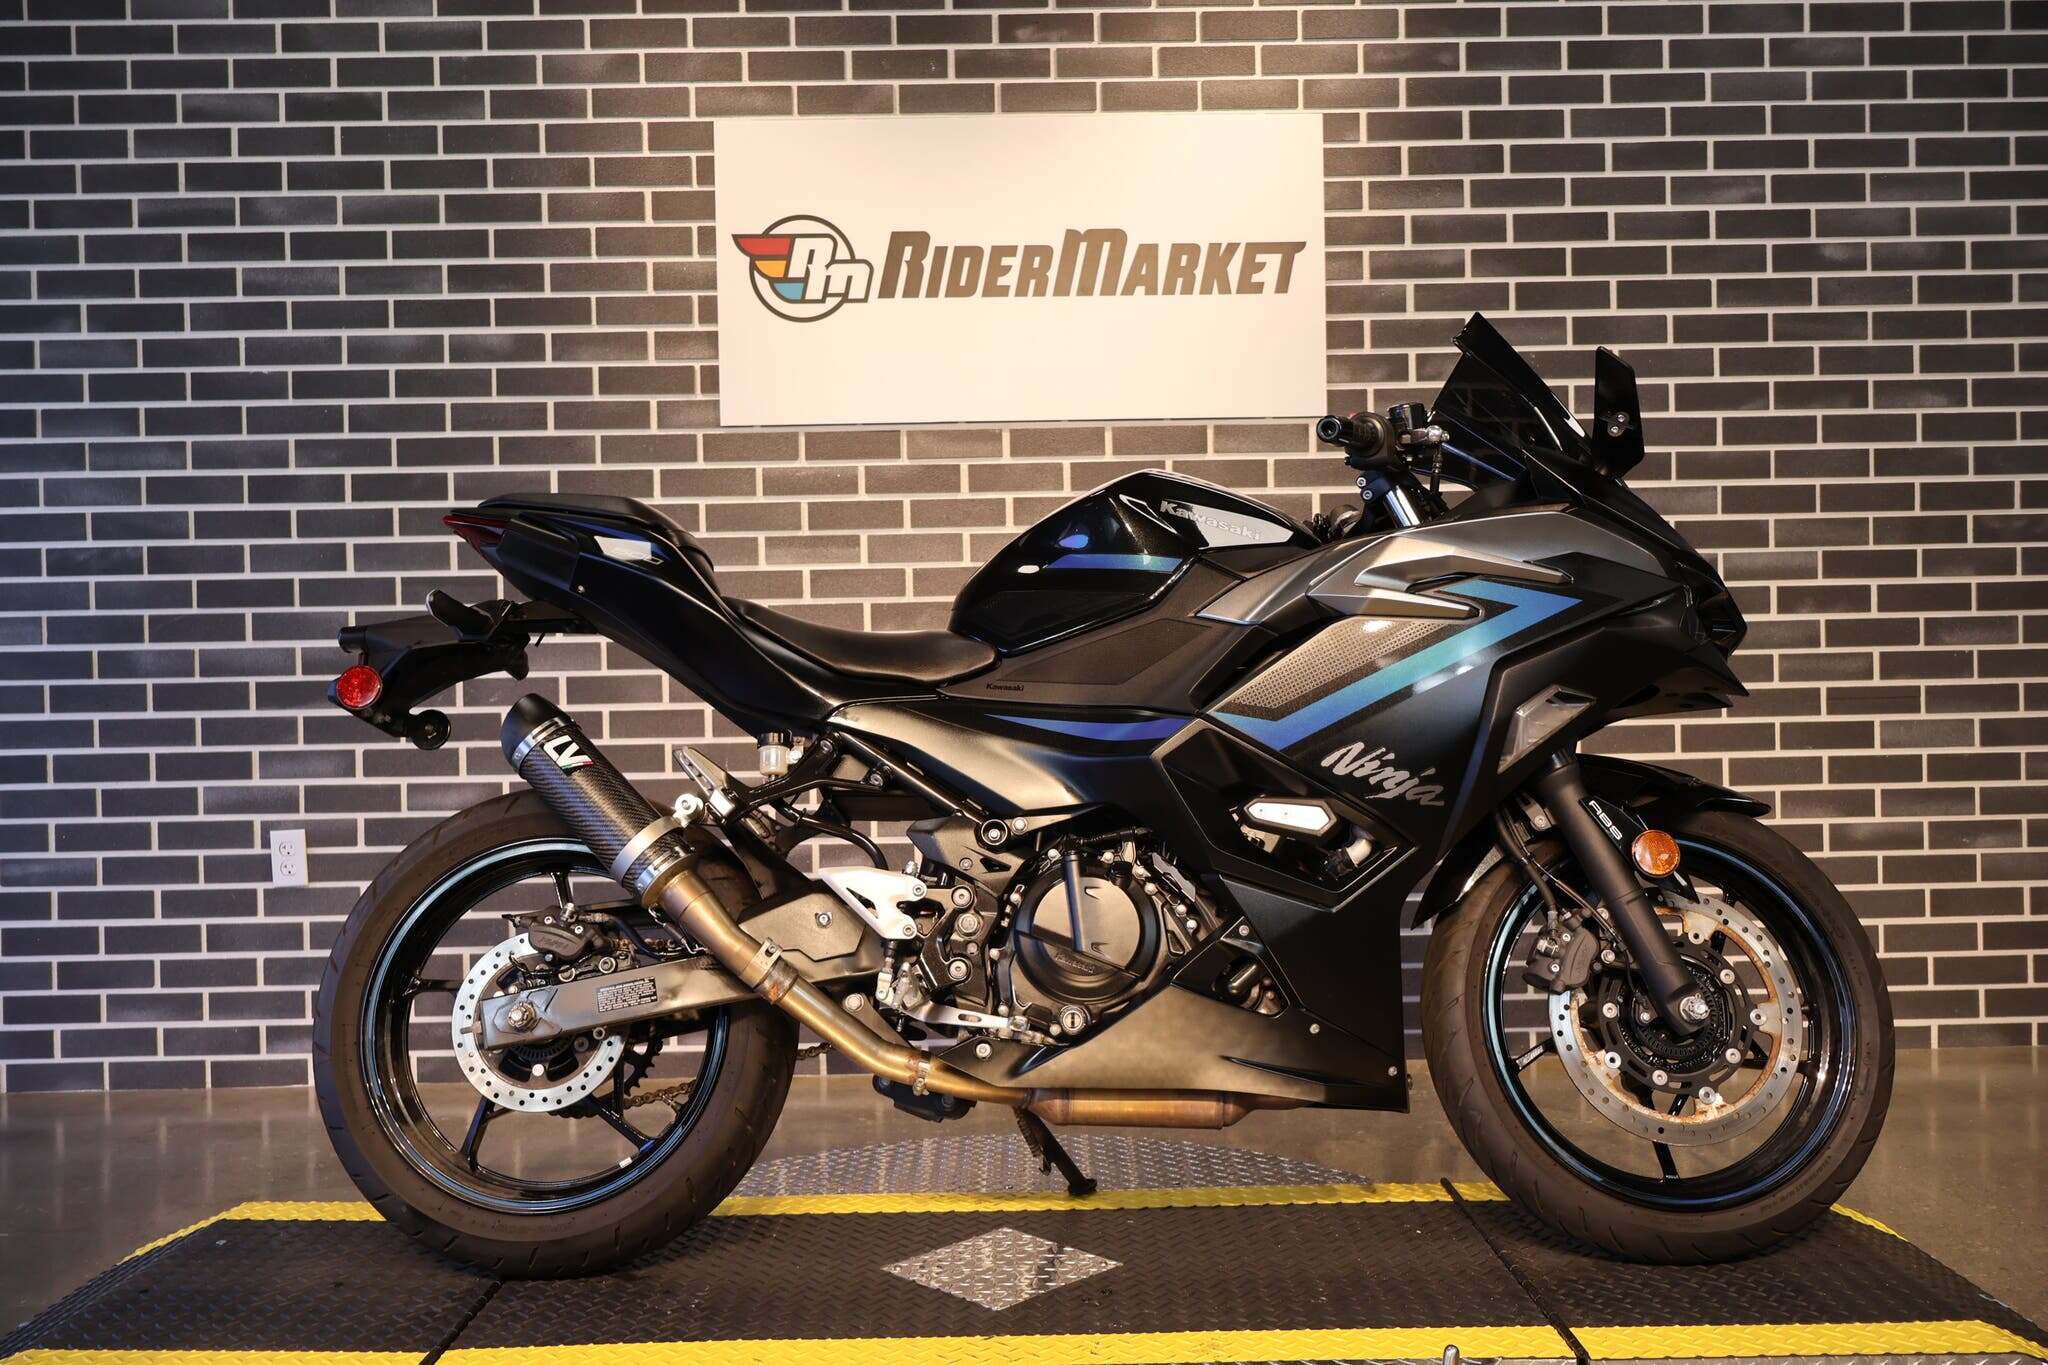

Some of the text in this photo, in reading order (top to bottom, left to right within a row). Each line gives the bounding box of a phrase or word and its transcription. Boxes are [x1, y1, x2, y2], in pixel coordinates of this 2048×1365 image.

[1160, 500, 1260, 540] Kawasaki
[1320, 741, 1445, 806] Ninja
[1588, 800, 1623, 840] ABS
